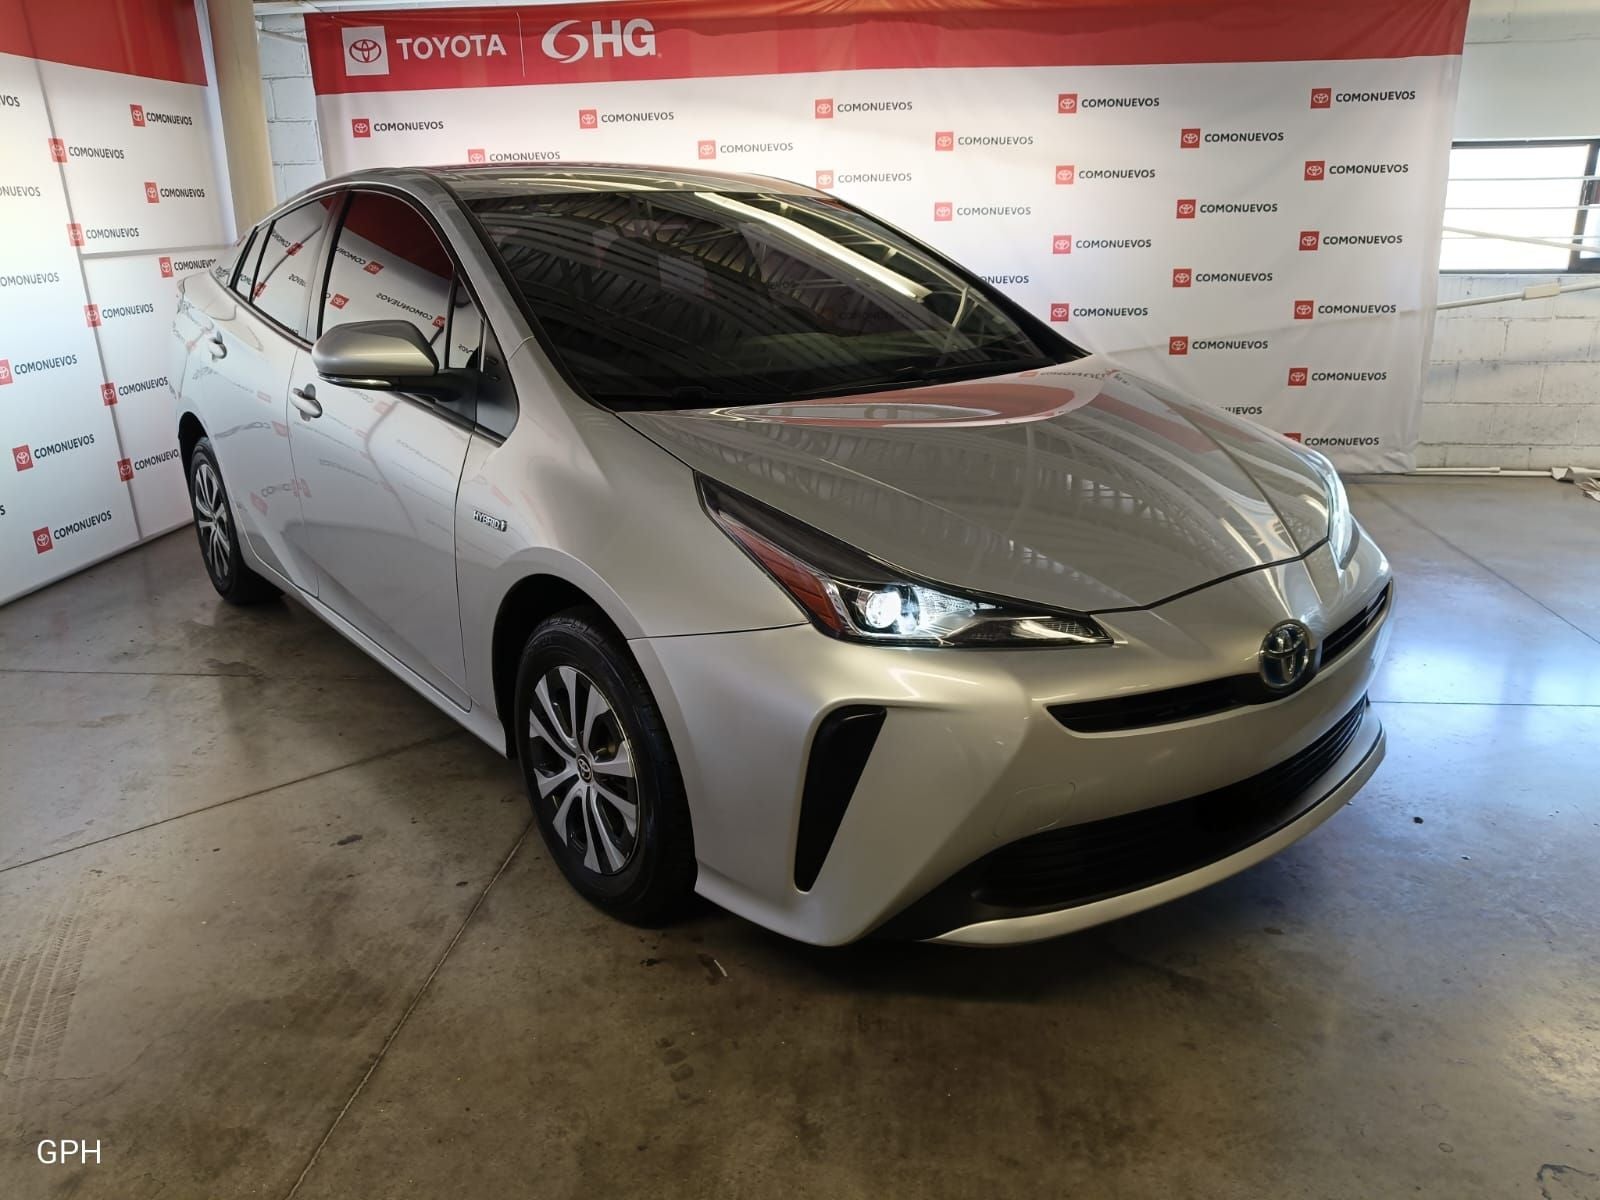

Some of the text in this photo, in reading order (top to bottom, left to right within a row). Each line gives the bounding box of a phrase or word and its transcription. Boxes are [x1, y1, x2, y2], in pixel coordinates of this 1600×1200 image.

[591, 18, 656, 58] HG
[396, 34, 507, 60] TOYOTA
[1336, 91, 1415, 102] COMONUEVOS
[838, 102, 912, 112] COMONUEVOS
[1082, 98, 1159, 107] COMONUEVOS
[146, 112, 193, 126] COMONUEVOS
[601, 112, 674, 122] COMONUEVOS
[374, 121, 443, 131] COMONUEVOS
[958, 137, 1033, 145] COMONUEVOS
[1205, 132, 1283, 142] COMONUEVOS
[69, 147, 124, 159] COMONUEVOS
[720, 143, 793, 153] COMONUEVOS
[489, 151, 561, 162] COMONUEVOS
[1079, 169, 1155, 178] COMONUEVOS
[1329, 164, 1408, 174] COMONUEVOS
[838, 173, 911, 183] COMONUEVOS
[160, 188, 205, 198] COMONUEVOS
[957, 207, 1031, 215] COMONUEVOS
[1200, 204, 1277, 213] COMONUEVOS
[86, 228, 139, 239] COMONUEVOS
[1076, 239, 1151, 248] COMONUEVOS
[1323, 235, 1402, 245] COMONUEVOS
[1196, 273, 1272, 281] COMONUEVOS
[102, 303, 155, 320] COMONUEVOS
[1073, 308, 1148, 316] COMONUEVOS
[1318, 305, 1396, 313] COMONUEVOS
[1192, 341, 1268, 349] COMONUEVOS
[15, 355, 77, 374] COMONUEVOS
[1312, 372, 1386, 381] COMONUEVOS
[118, 376, 169, 397] COMONUEVOS
[34, 434, 94, 459] COMONUEVOS
[1305, 438, 1379, 446] COMONUEVOS
[134, 448, 181, 471] COMONUEVO
[53, 510, 112, 540] COMONUEVOS
[473, 510, 501, 530] HYBRID
